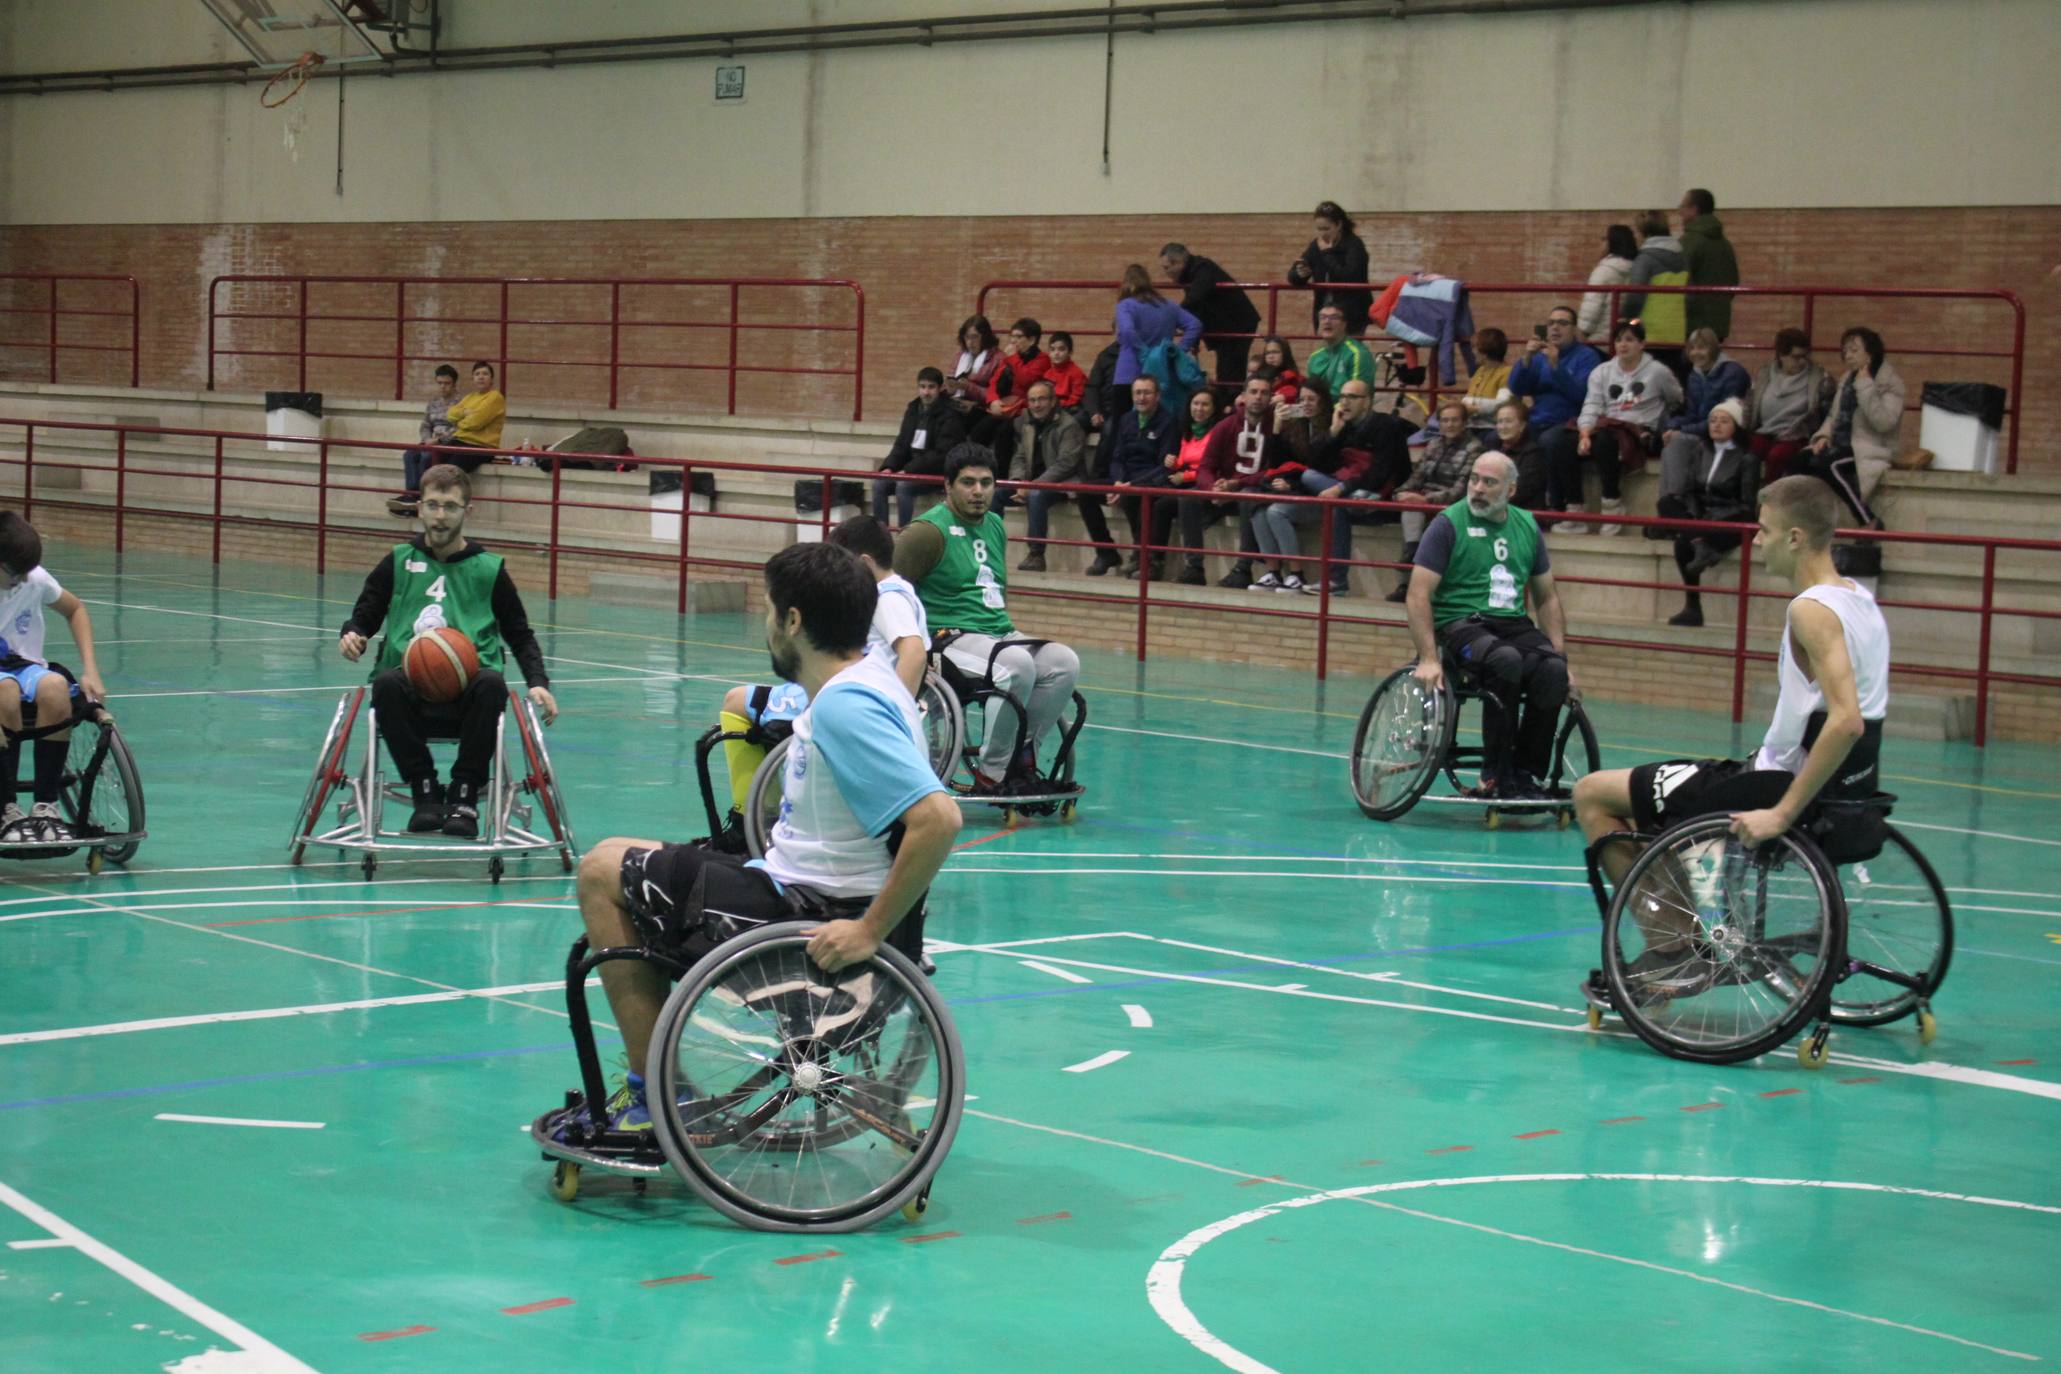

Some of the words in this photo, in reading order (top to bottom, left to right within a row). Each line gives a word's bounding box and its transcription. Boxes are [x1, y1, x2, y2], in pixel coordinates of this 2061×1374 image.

[1235, 431, 1265, 475] 9
[973, 538, 988, 563] 8
[1493, 537, 1509, 562] 6
[425, 575, 447, 602] 4
